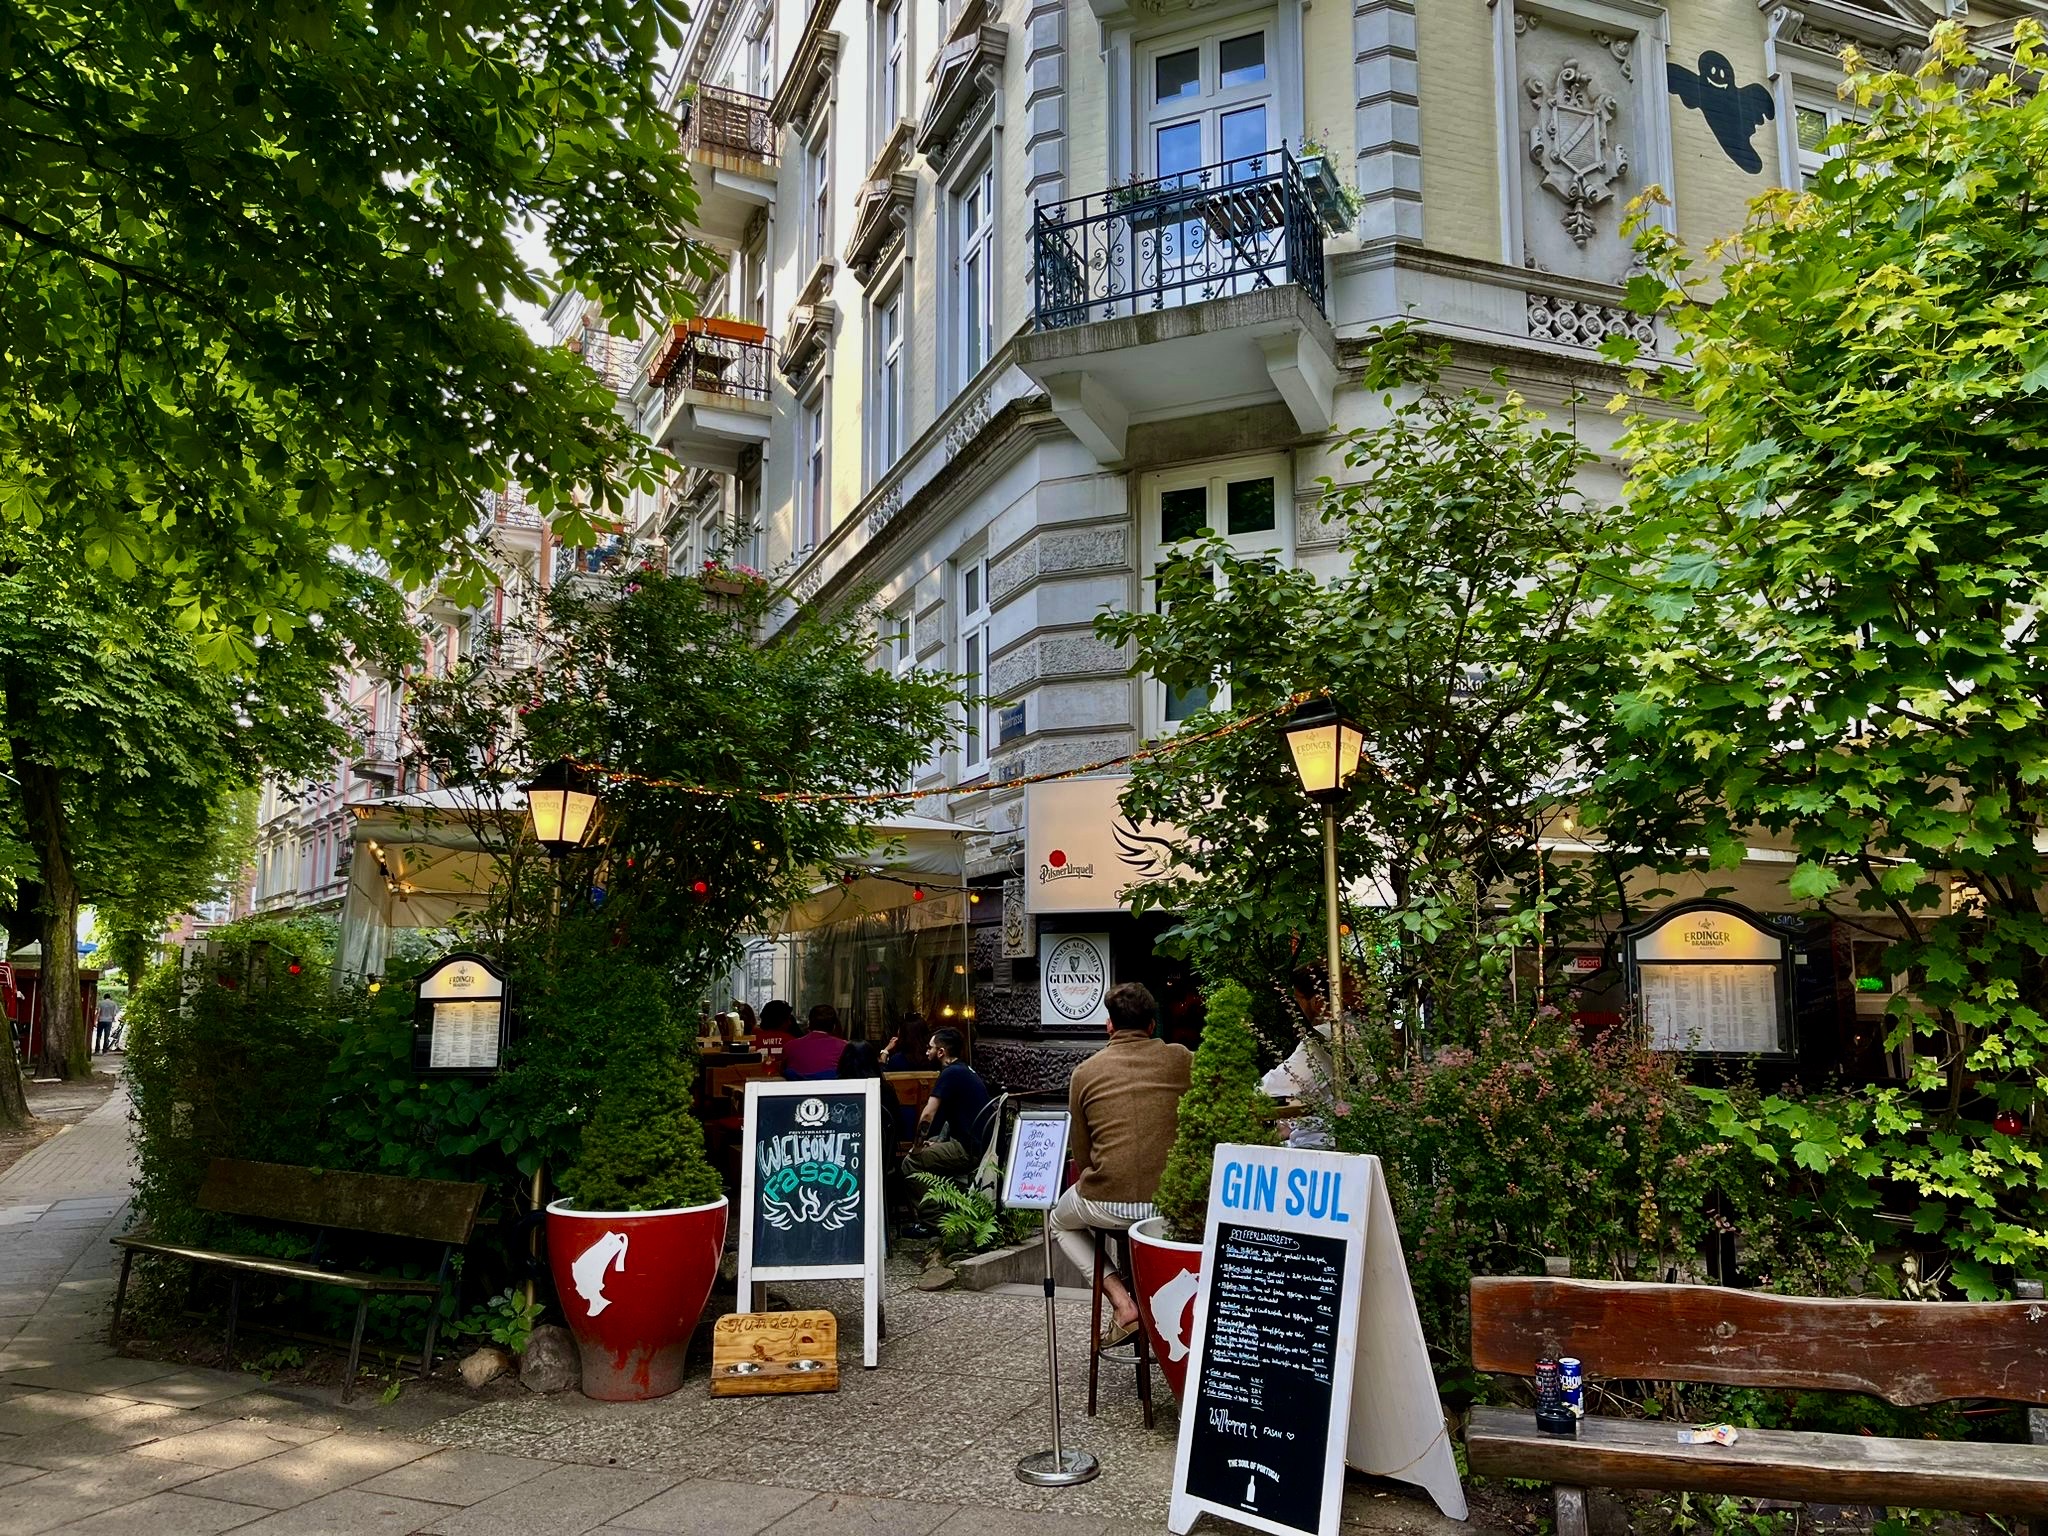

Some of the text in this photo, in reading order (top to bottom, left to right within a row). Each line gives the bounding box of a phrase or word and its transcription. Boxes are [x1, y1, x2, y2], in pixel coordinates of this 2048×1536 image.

[1296, 741, 1333, 754] ERDINGER
[1040, 863, 1094, 885] Pilsner Urquell
[1684, 931, 1730, 942] ERDINGER
[1051, 942, 1100, 973] GUINNESS AUS DUBLIN
[1578, 959, 1599, 967] sport
[449, 975, 475, 985] ERDINGER
[1049, 974, 1101, 984] GUINNESS
[1051, 988, 1076, 1015] BRAUEREI
[1078, 1002, 1092, 1015] SEIT
[1090, 988, 1099, 1002] 1759
[758, 1133, 850, 1178] WELCOME
[1222, 1162, 1349, 1222] GIN SUL
[1263, 1426, 1283, 1438] FASAN
[1227, 1459, 1280, 1483] THE SOUL OF PORTUGAL
